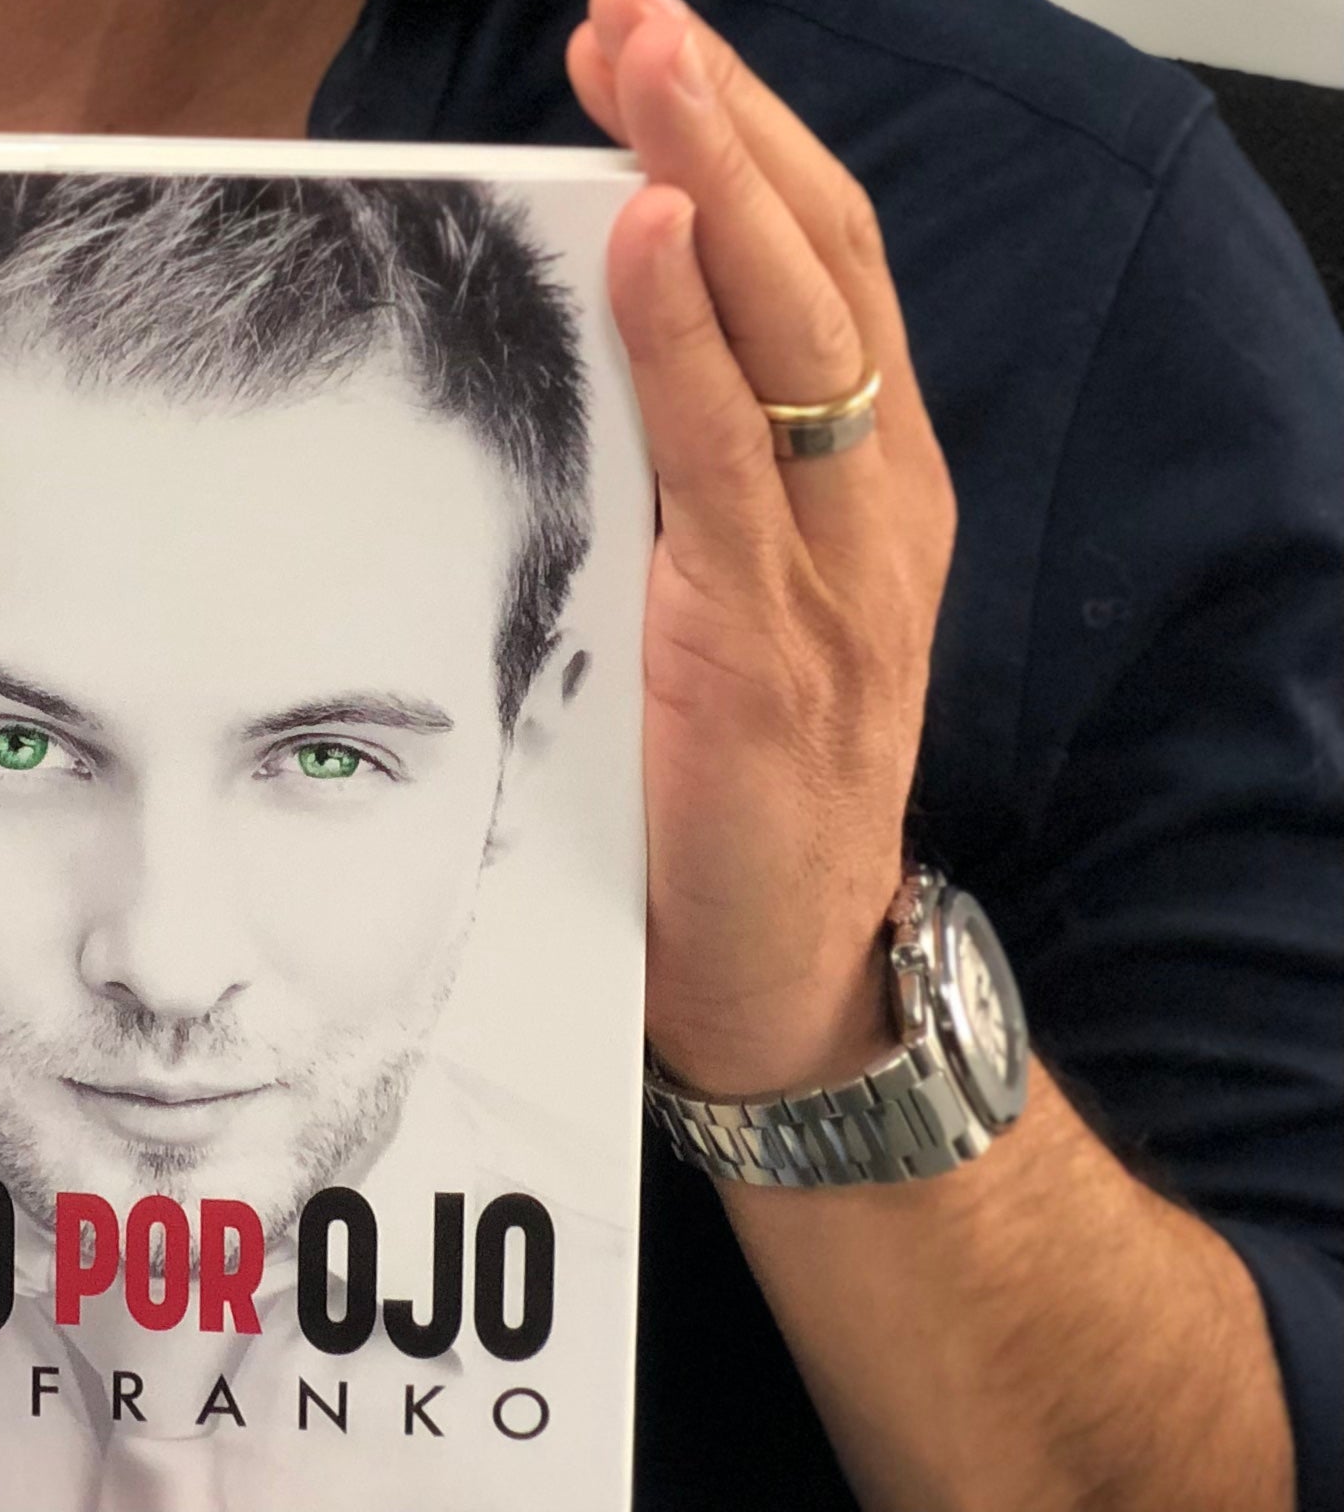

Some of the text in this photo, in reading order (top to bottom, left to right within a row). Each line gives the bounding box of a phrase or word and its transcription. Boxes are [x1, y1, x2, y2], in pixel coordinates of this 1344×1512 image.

[54, 1190, 265, 1335] POR
[297, 1185, 555, 1362] OJO
[30, 1365, 550, 1441] FRANKO
